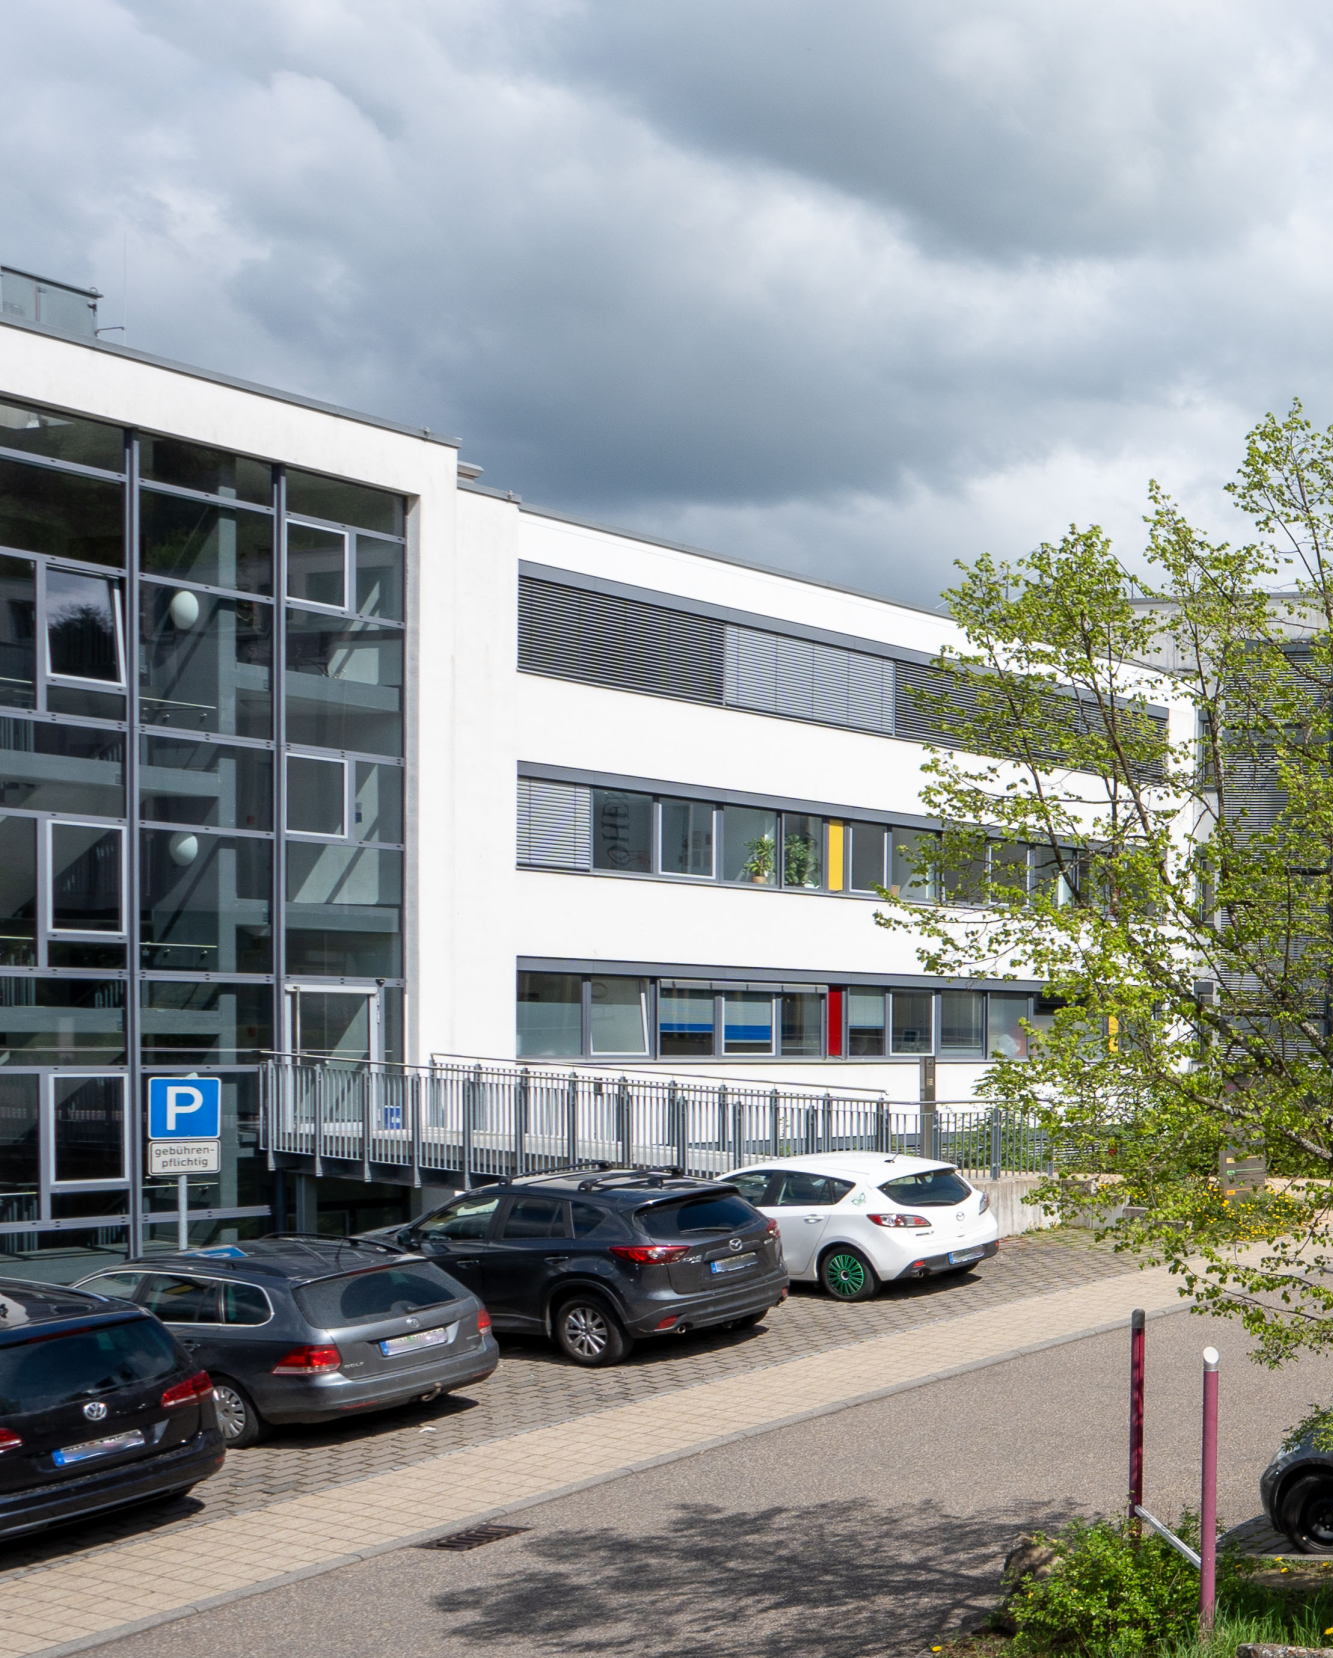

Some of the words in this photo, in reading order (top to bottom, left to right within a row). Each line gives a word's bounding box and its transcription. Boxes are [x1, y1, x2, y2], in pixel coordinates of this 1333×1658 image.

[166, 1086, 203, 1130] P
[155, 1146, 215, 1157] gebühren-
[162, 1157, 208, 1169] pflichtig
